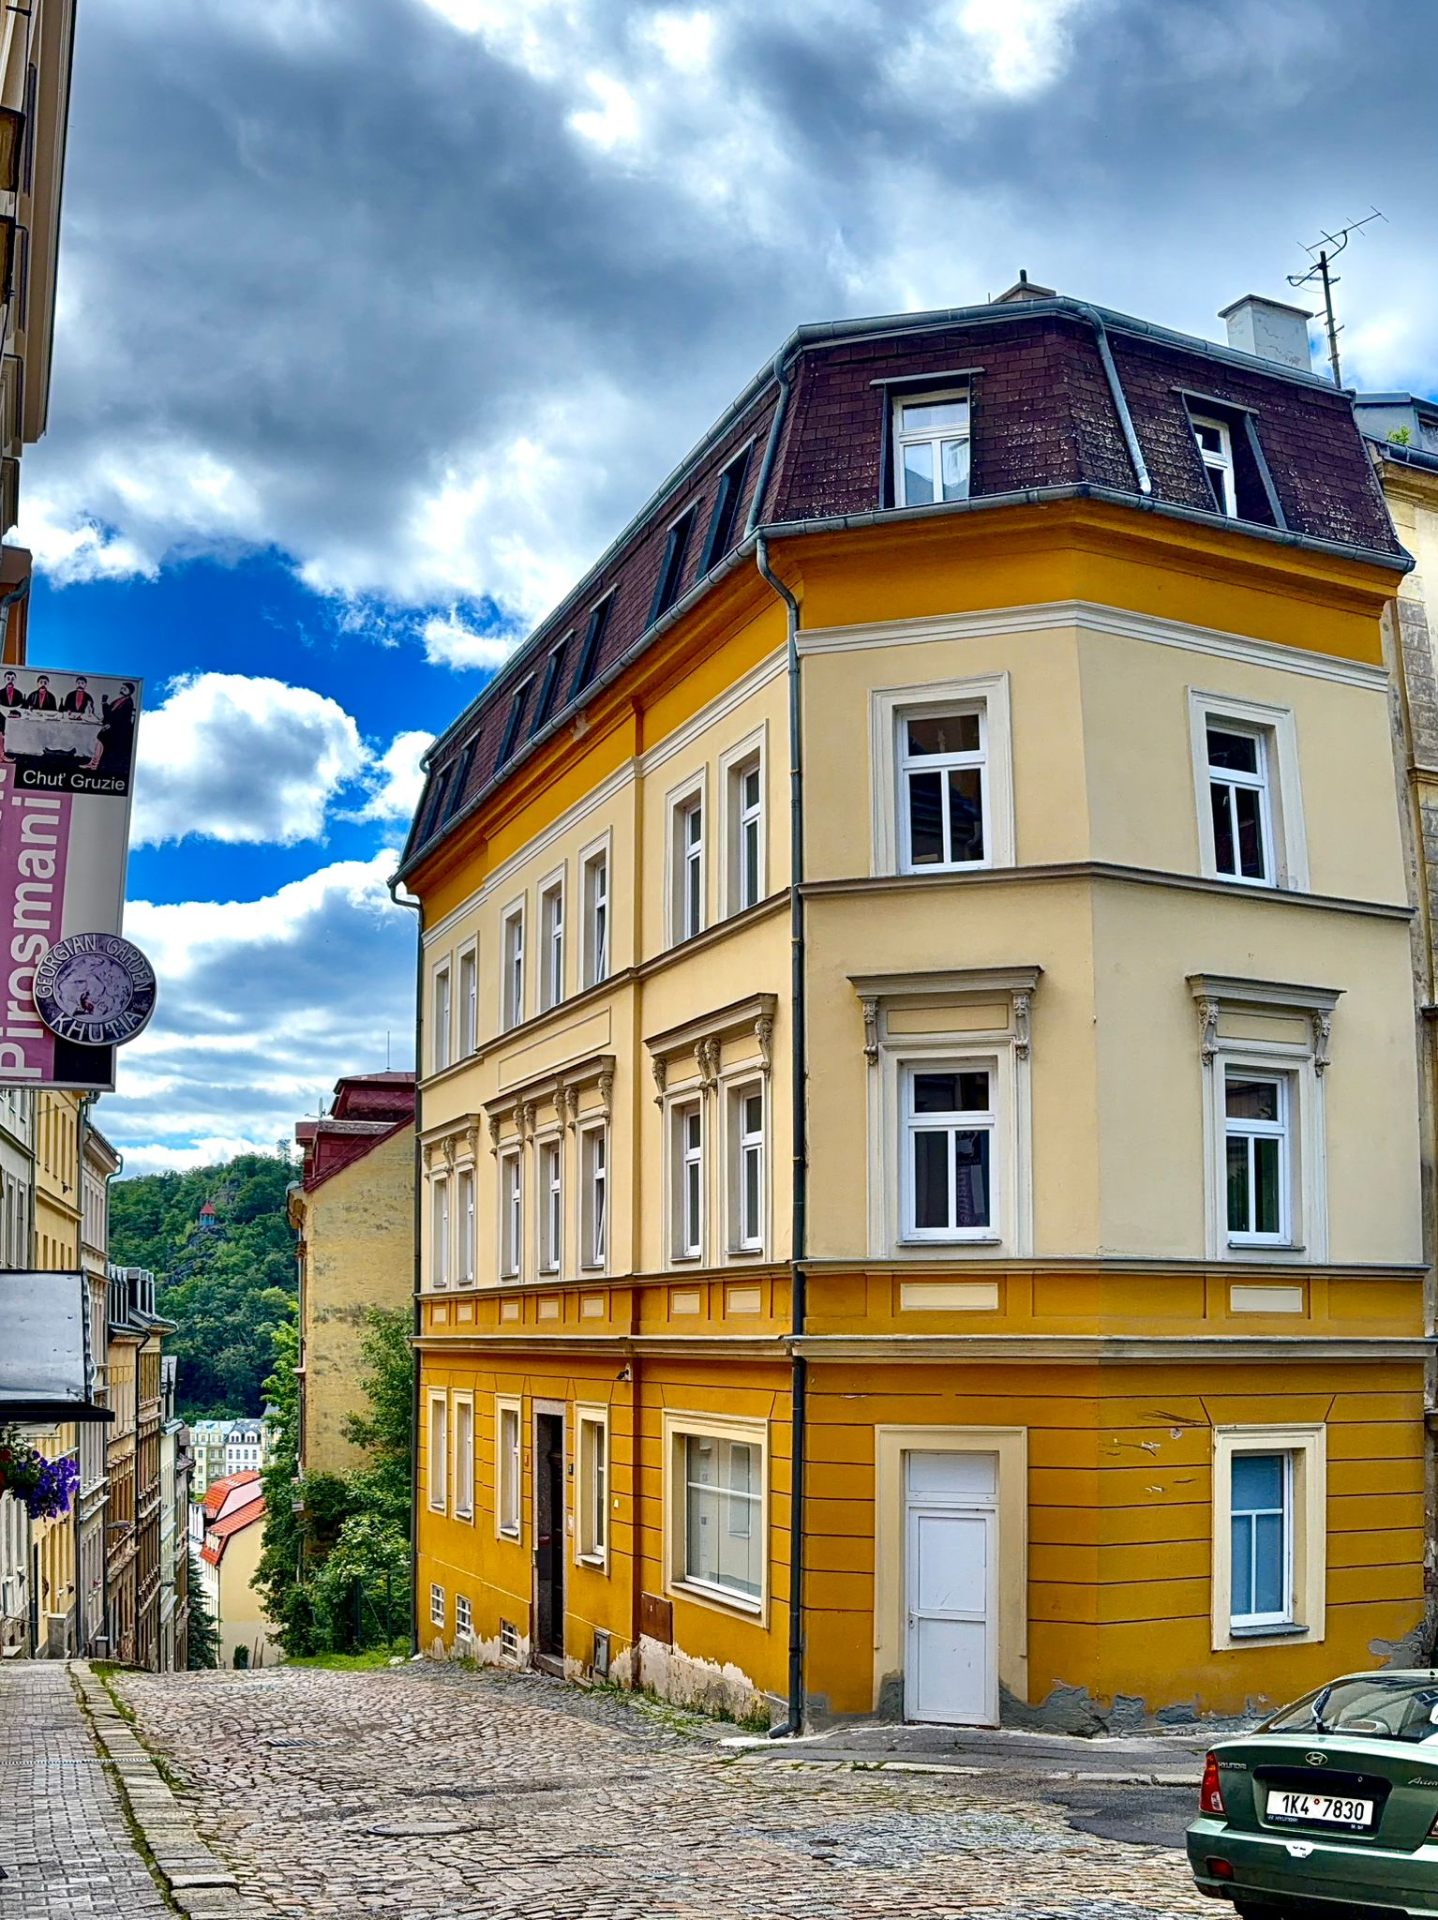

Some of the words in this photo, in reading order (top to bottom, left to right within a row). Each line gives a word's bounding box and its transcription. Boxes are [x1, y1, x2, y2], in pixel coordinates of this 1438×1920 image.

[70, 773, 126, 791] Gruzie
[0, 796, 61, 1078] Pirosmani
[35, 934, 97, 999] GEORGIAN
[106, 938, 151, 993] GARDEN
[50, 1011, 144, 1043] KHUTIA
[1282, 1794, 1310, 1815] 1K4
[1322, 1798, 1365, 1821] 7830
